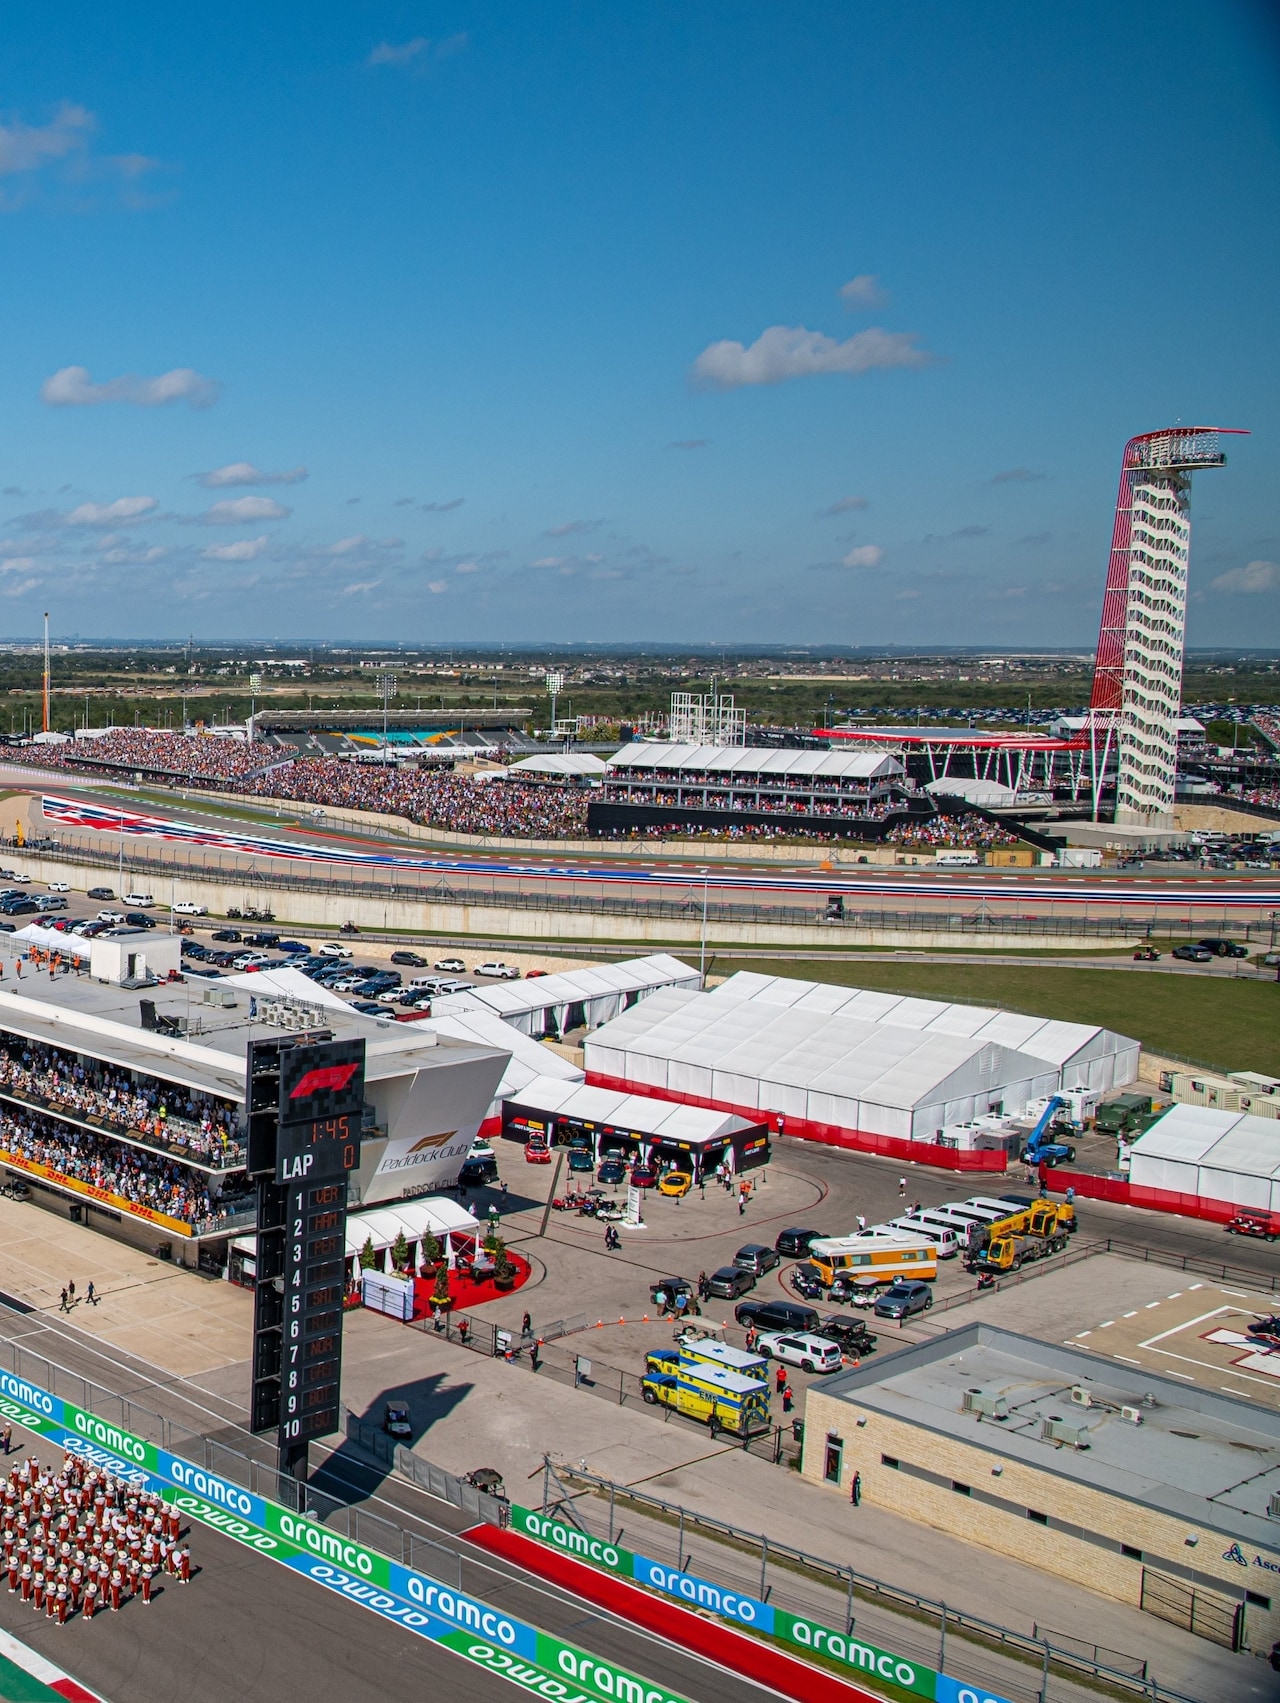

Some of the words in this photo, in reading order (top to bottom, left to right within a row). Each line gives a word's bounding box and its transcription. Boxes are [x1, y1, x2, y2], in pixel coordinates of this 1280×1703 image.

[288, 1063, 360, 1099] F1
[312, 1116, 350, 1143] 1:45
[406, 1130, 458, 1154] F1
[9, 1155, 30, 1169] DHL
[282, 1153, 314, 1180] LAP
[343, 1144, 354, 1169] 0
[381, 1150, 440, 1171] Paddock
[440, 1143, 468, 1159] Club
[47, 1170, 70, 1185] DHL
[87, 1186, 111, 1202] DHL
[296, 1192, 303, 1211] 1
[315, 1186, 338, 1204] VER
[130, 1203, 155, 1219] DHL
[294, 1219, 303, 1237] 2
[315, 1213, 337, 1231] HAM
[293, 1244, 302, 1262] 3
[314, 1237, 336, 1255] PER
[292, 1269, 301, 1287] 4
[291, 1295, 300, 1313] 5
[312, 1287, 334, 1306] SAI
[290, 1320, 299, 1338] 6
[289, 1345, 299, 1363] 7
[310, 1337, 333, 1356] NOR
[288, 1370, 297, 1389] 8
[288, 1395, 297, 1413] 9
[700, 1390, 718, 1404] EMS
[75, 1412, 145, 1461] aramco
[283, 1419, 300, 1439] 10
[171, 1461, 252, 1515] aramco
[176, 1497, 278, 1549] aramco
[280, 1515, 372, 1575] aramco
[525, 1513, 619, 1567] aramco
[310, 1565, 429, 1627] aramco
[649, 1566, 756, 1622] aramco
[407, 1577, 516, 1646] aramco
[792, 1621, 915, 1686] aramco
[558, 1649, 677, 1703] aramc
